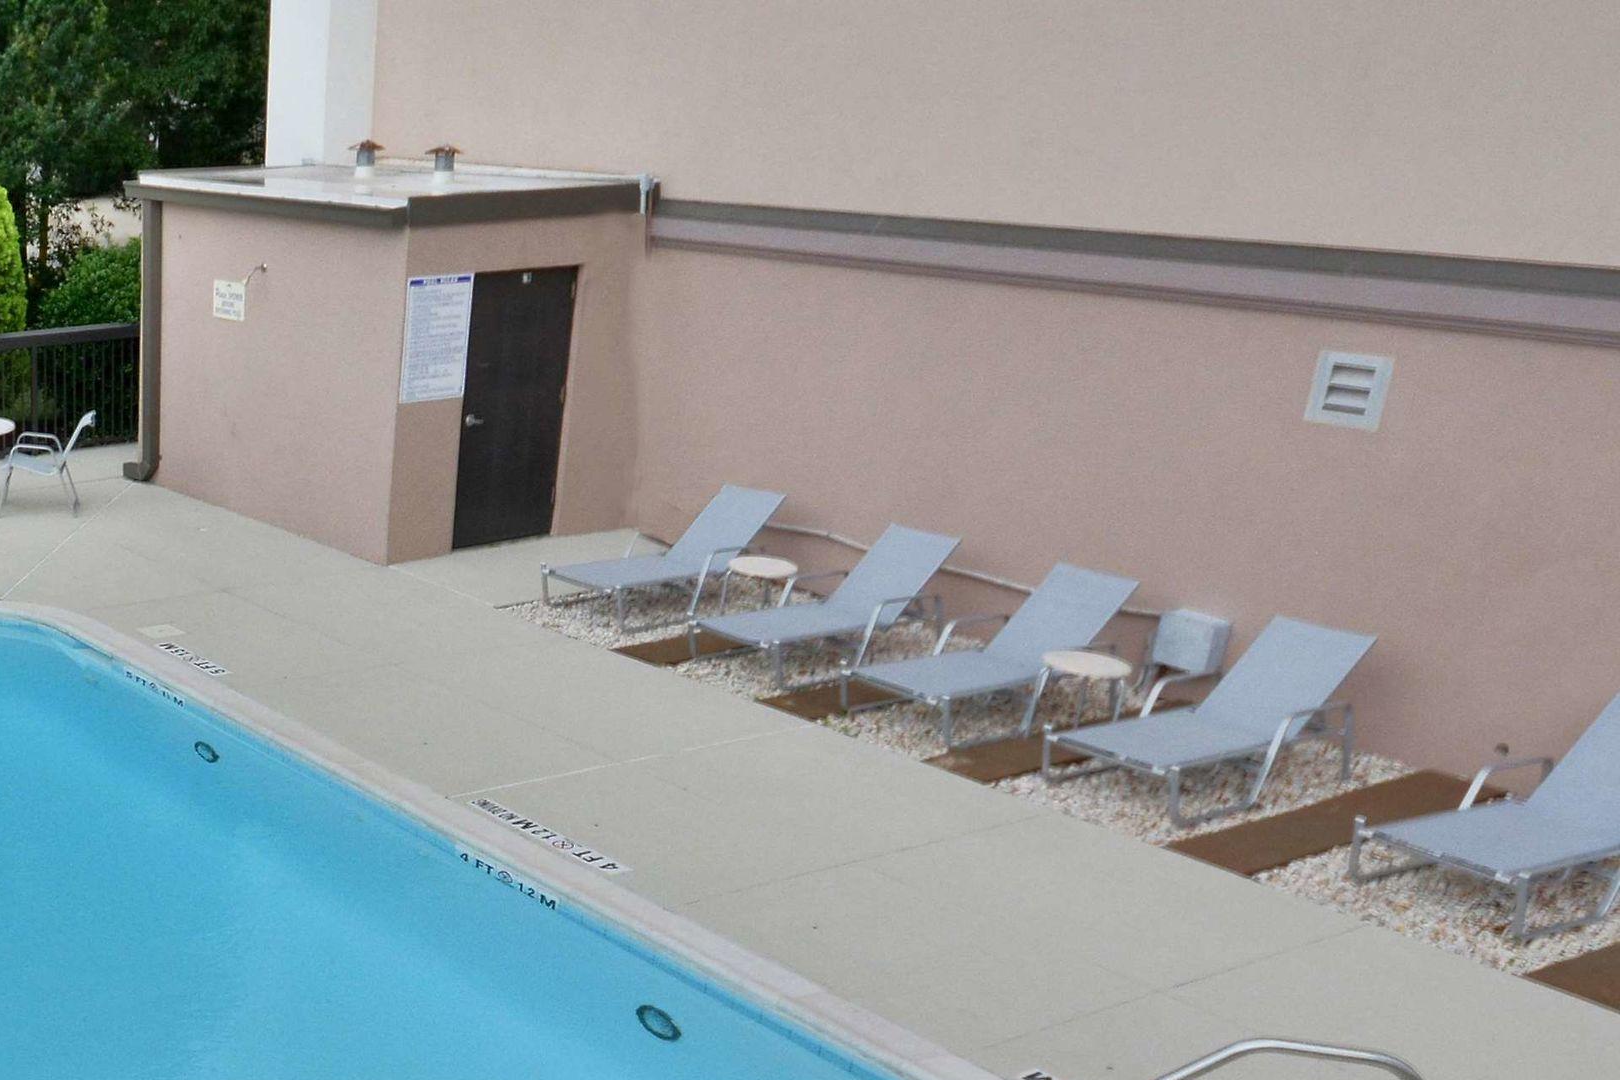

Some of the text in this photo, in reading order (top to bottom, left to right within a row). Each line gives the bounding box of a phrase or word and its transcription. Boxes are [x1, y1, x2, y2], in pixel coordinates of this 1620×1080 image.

[572, 849, 603, 863] FT
[599, 861, 619, 871] 4
[460, 853, 469, 863] 4
[474, 858, 494, 875] FT
[540, 895, 557, 910] M
